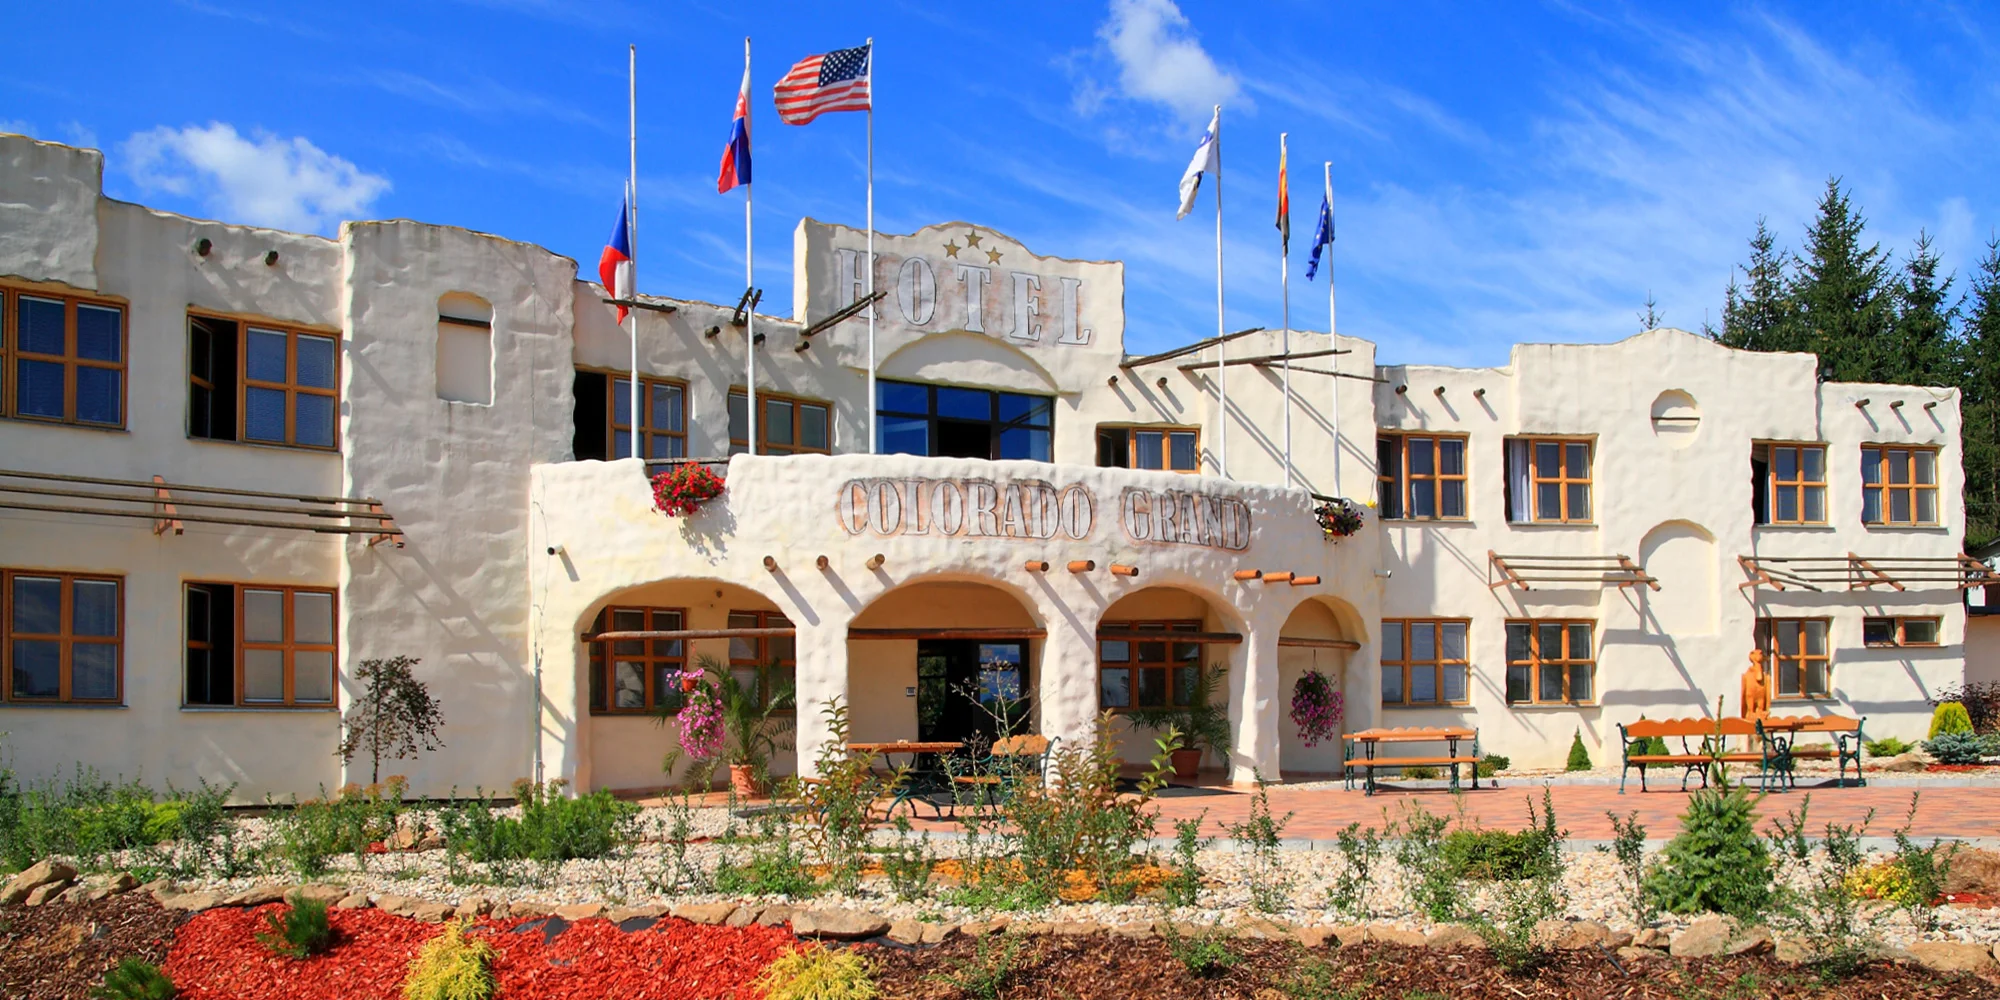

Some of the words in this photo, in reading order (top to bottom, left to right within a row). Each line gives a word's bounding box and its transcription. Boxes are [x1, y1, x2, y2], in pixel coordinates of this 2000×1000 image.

[837, 248, 1091, 345] HOTEL
[839, 479, 1093, 540] COLORADO
[1124, 488, 1252, 551] GRAND
